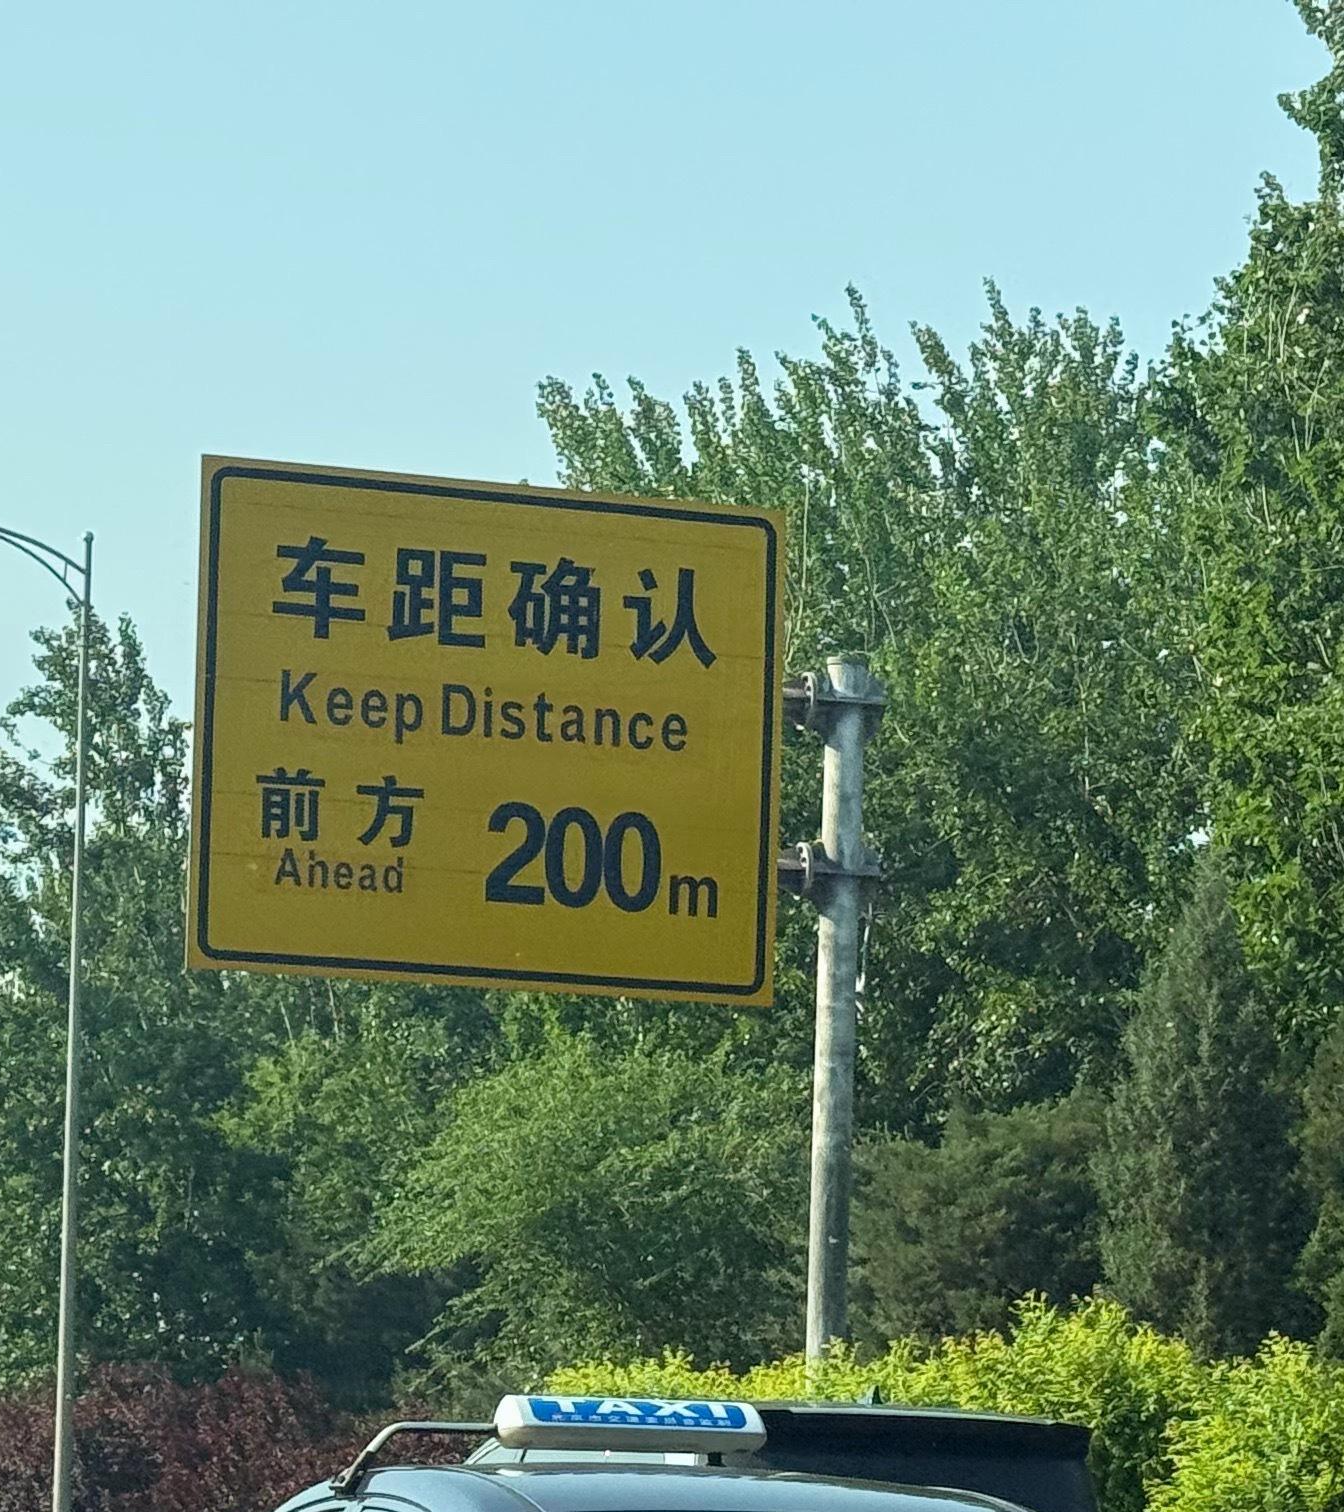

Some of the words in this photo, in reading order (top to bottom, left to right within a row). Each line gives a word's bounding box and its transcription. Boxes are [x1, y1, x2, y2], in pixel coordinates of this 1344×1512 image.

[271, 535, 718, 669] 车距确认
[279, 669, 424, 745] Keep
[440, 683, 689, 752] Distance
[256, 766, 425, 848] 前方
[273, 848, 405, 894] Ahead
[483, 801, 718, 918] 200m
[544, 1399, 732, 1419] TAXI
